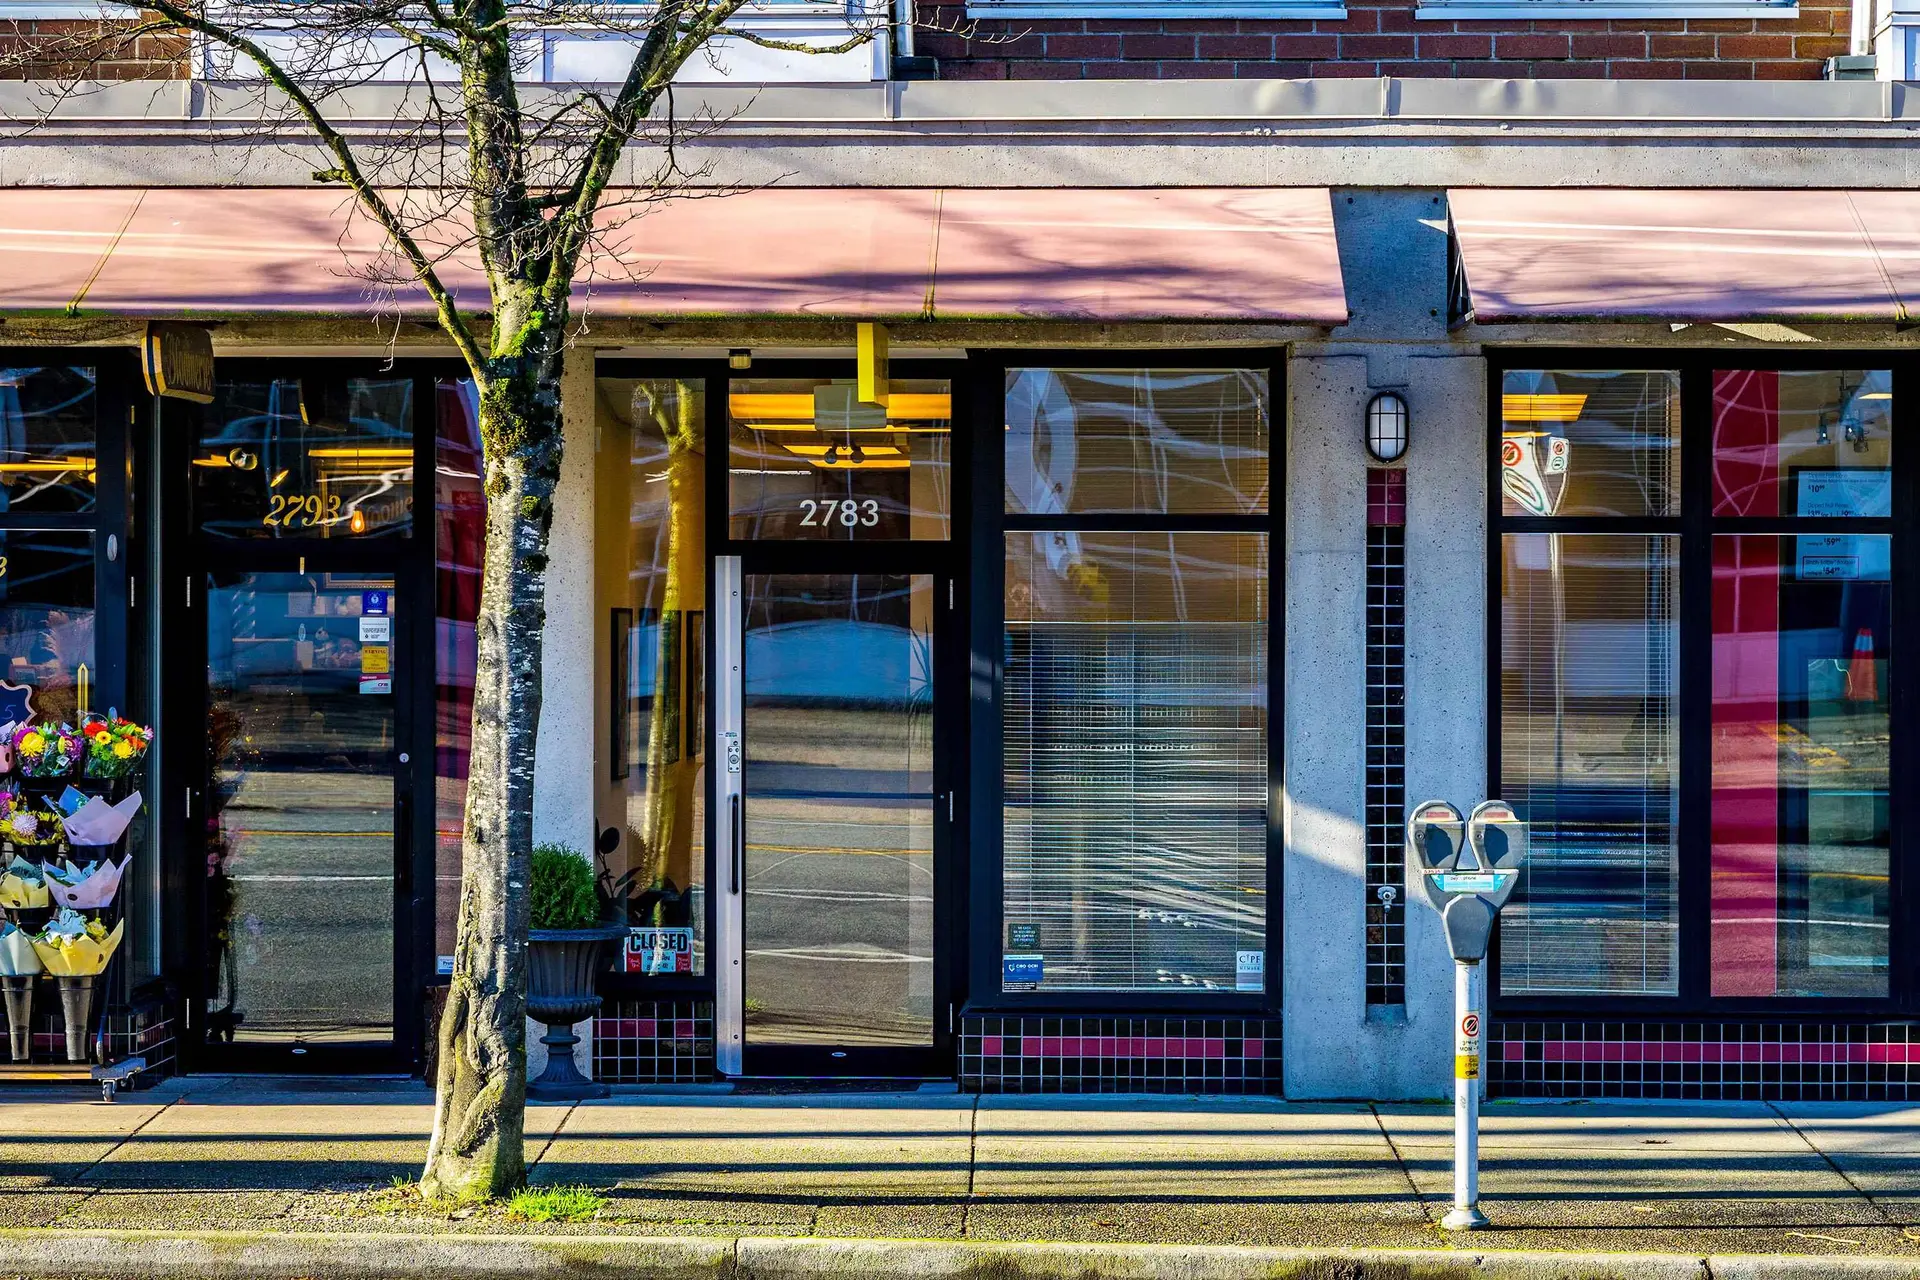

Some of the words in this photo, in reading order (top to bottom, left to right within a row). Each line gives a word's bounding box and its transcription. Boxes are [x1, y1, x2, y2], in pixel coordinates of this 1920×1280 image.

[263, 494, 341, 526] 2793
[799, 499, 879, 527] 2783
[630, 933, 688, 952] CLOSED
